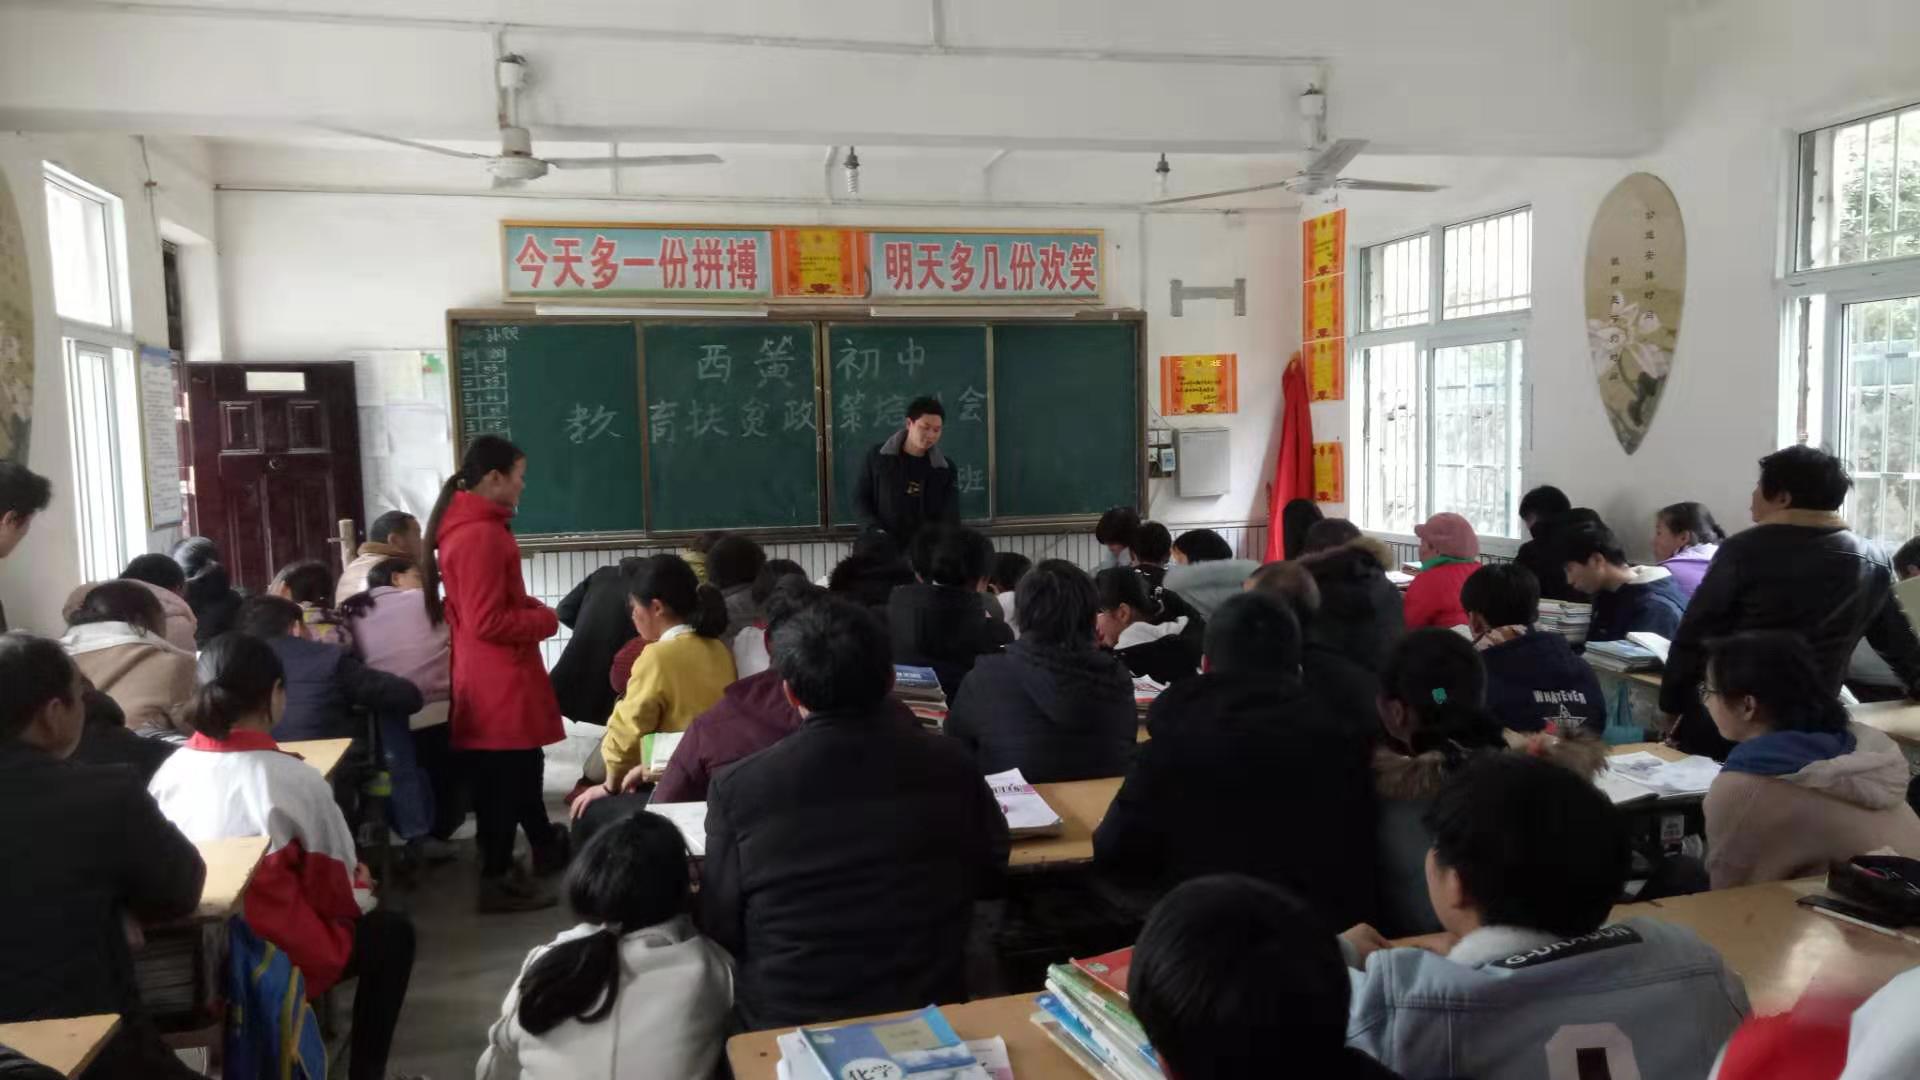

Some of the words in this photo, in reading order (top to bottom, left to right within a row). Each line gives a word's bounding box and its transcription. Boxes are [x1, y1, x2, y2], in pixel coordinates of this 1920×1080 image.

[514, 235, 758, 290] 今天多一份拼搏
[884, 241, 1097, 292] 明天多几份欢笑
[564, 386, 985, 444] 教育扶贫政策培会
[1532, 690, 1587, 704] WHATEVER
